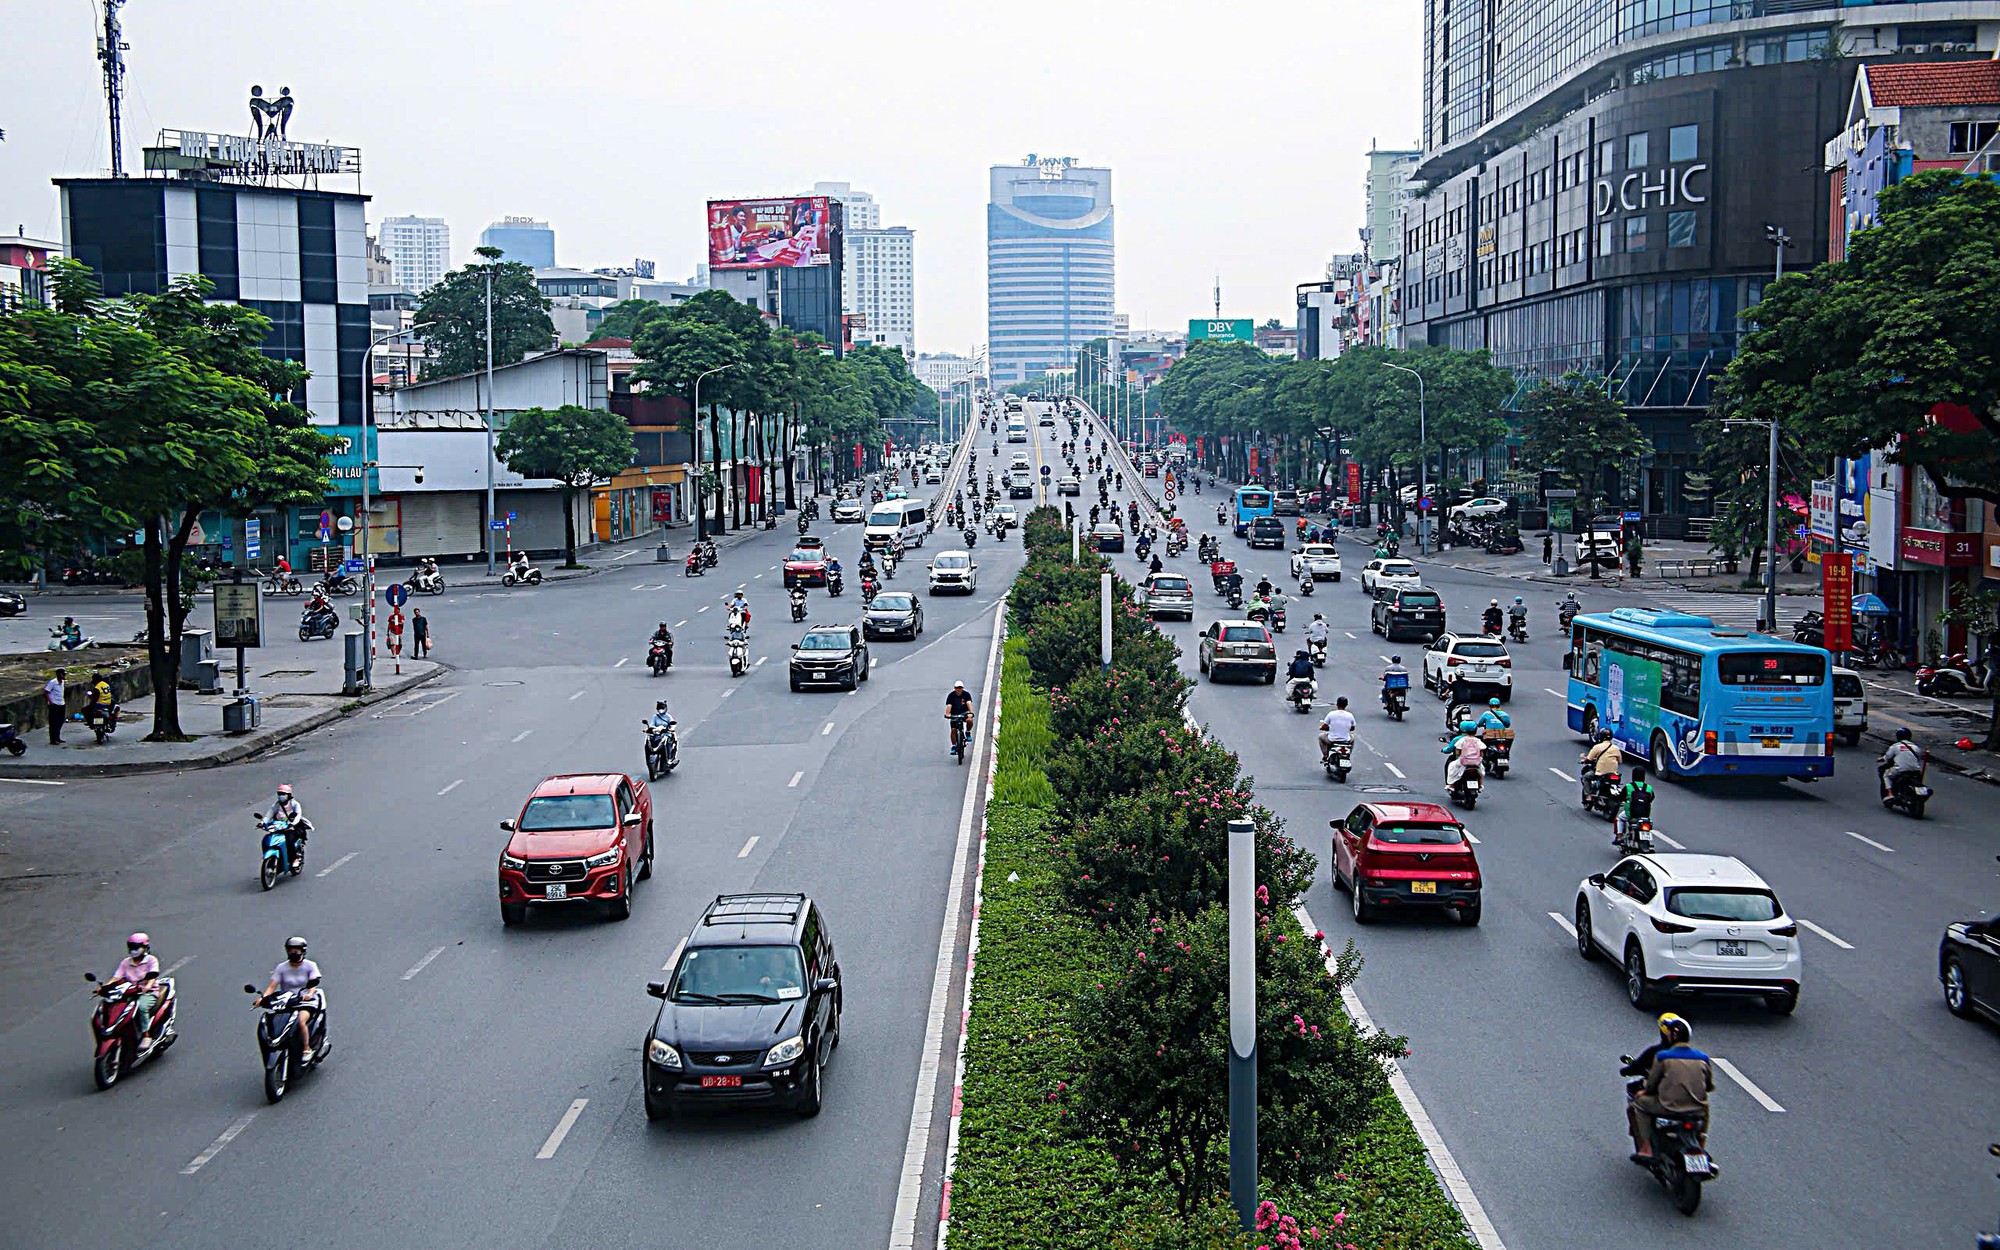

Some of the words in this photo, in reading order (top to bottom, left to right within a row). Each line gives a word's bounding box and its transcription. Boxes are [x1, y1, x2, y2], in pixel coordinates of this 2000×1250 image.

[1596, 164, 1706, 216] D.CHIC
[512, 216, 534, 224] ROX
[1207, 321, 1235, 333] DBV
[1956, 542, 1969, 552] 31
[1829, 565, 1847, 576] 19-8
